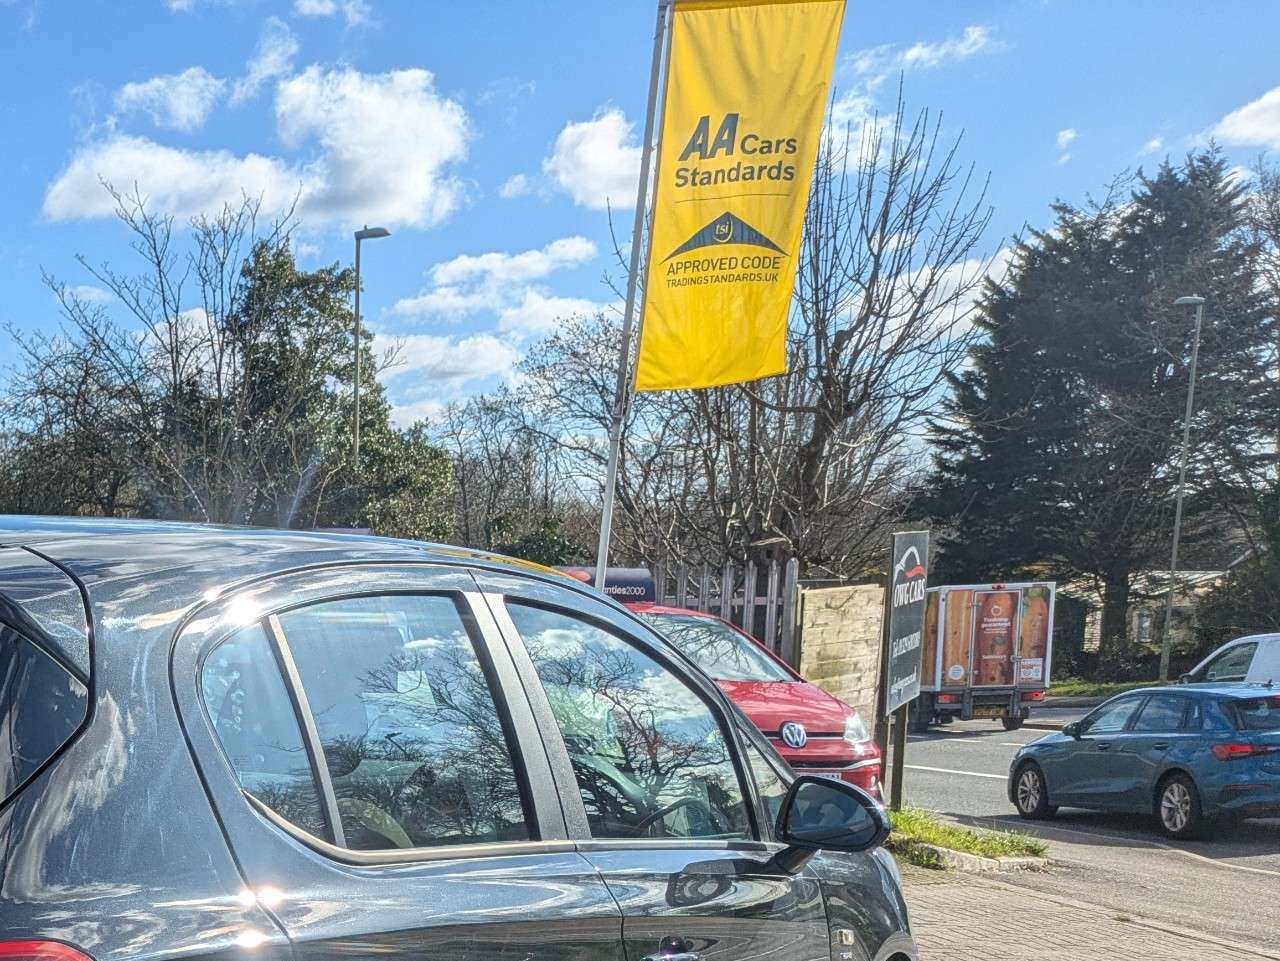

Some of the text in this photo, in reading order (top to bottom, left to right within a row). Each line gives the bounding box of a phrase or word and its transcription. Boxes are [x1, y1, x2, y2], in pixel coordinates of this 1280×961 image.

[677, 113, 798, 161] AA Cars
[674, 161, 795, 188] Standards
[715, 221, 730, 235] tsi
[666, 255, 782, 276] APPROVED CODE
[666, 272, 779, 289] TRADINGSTANDARDS.UK
[894, 582, 910, 608] OWG
